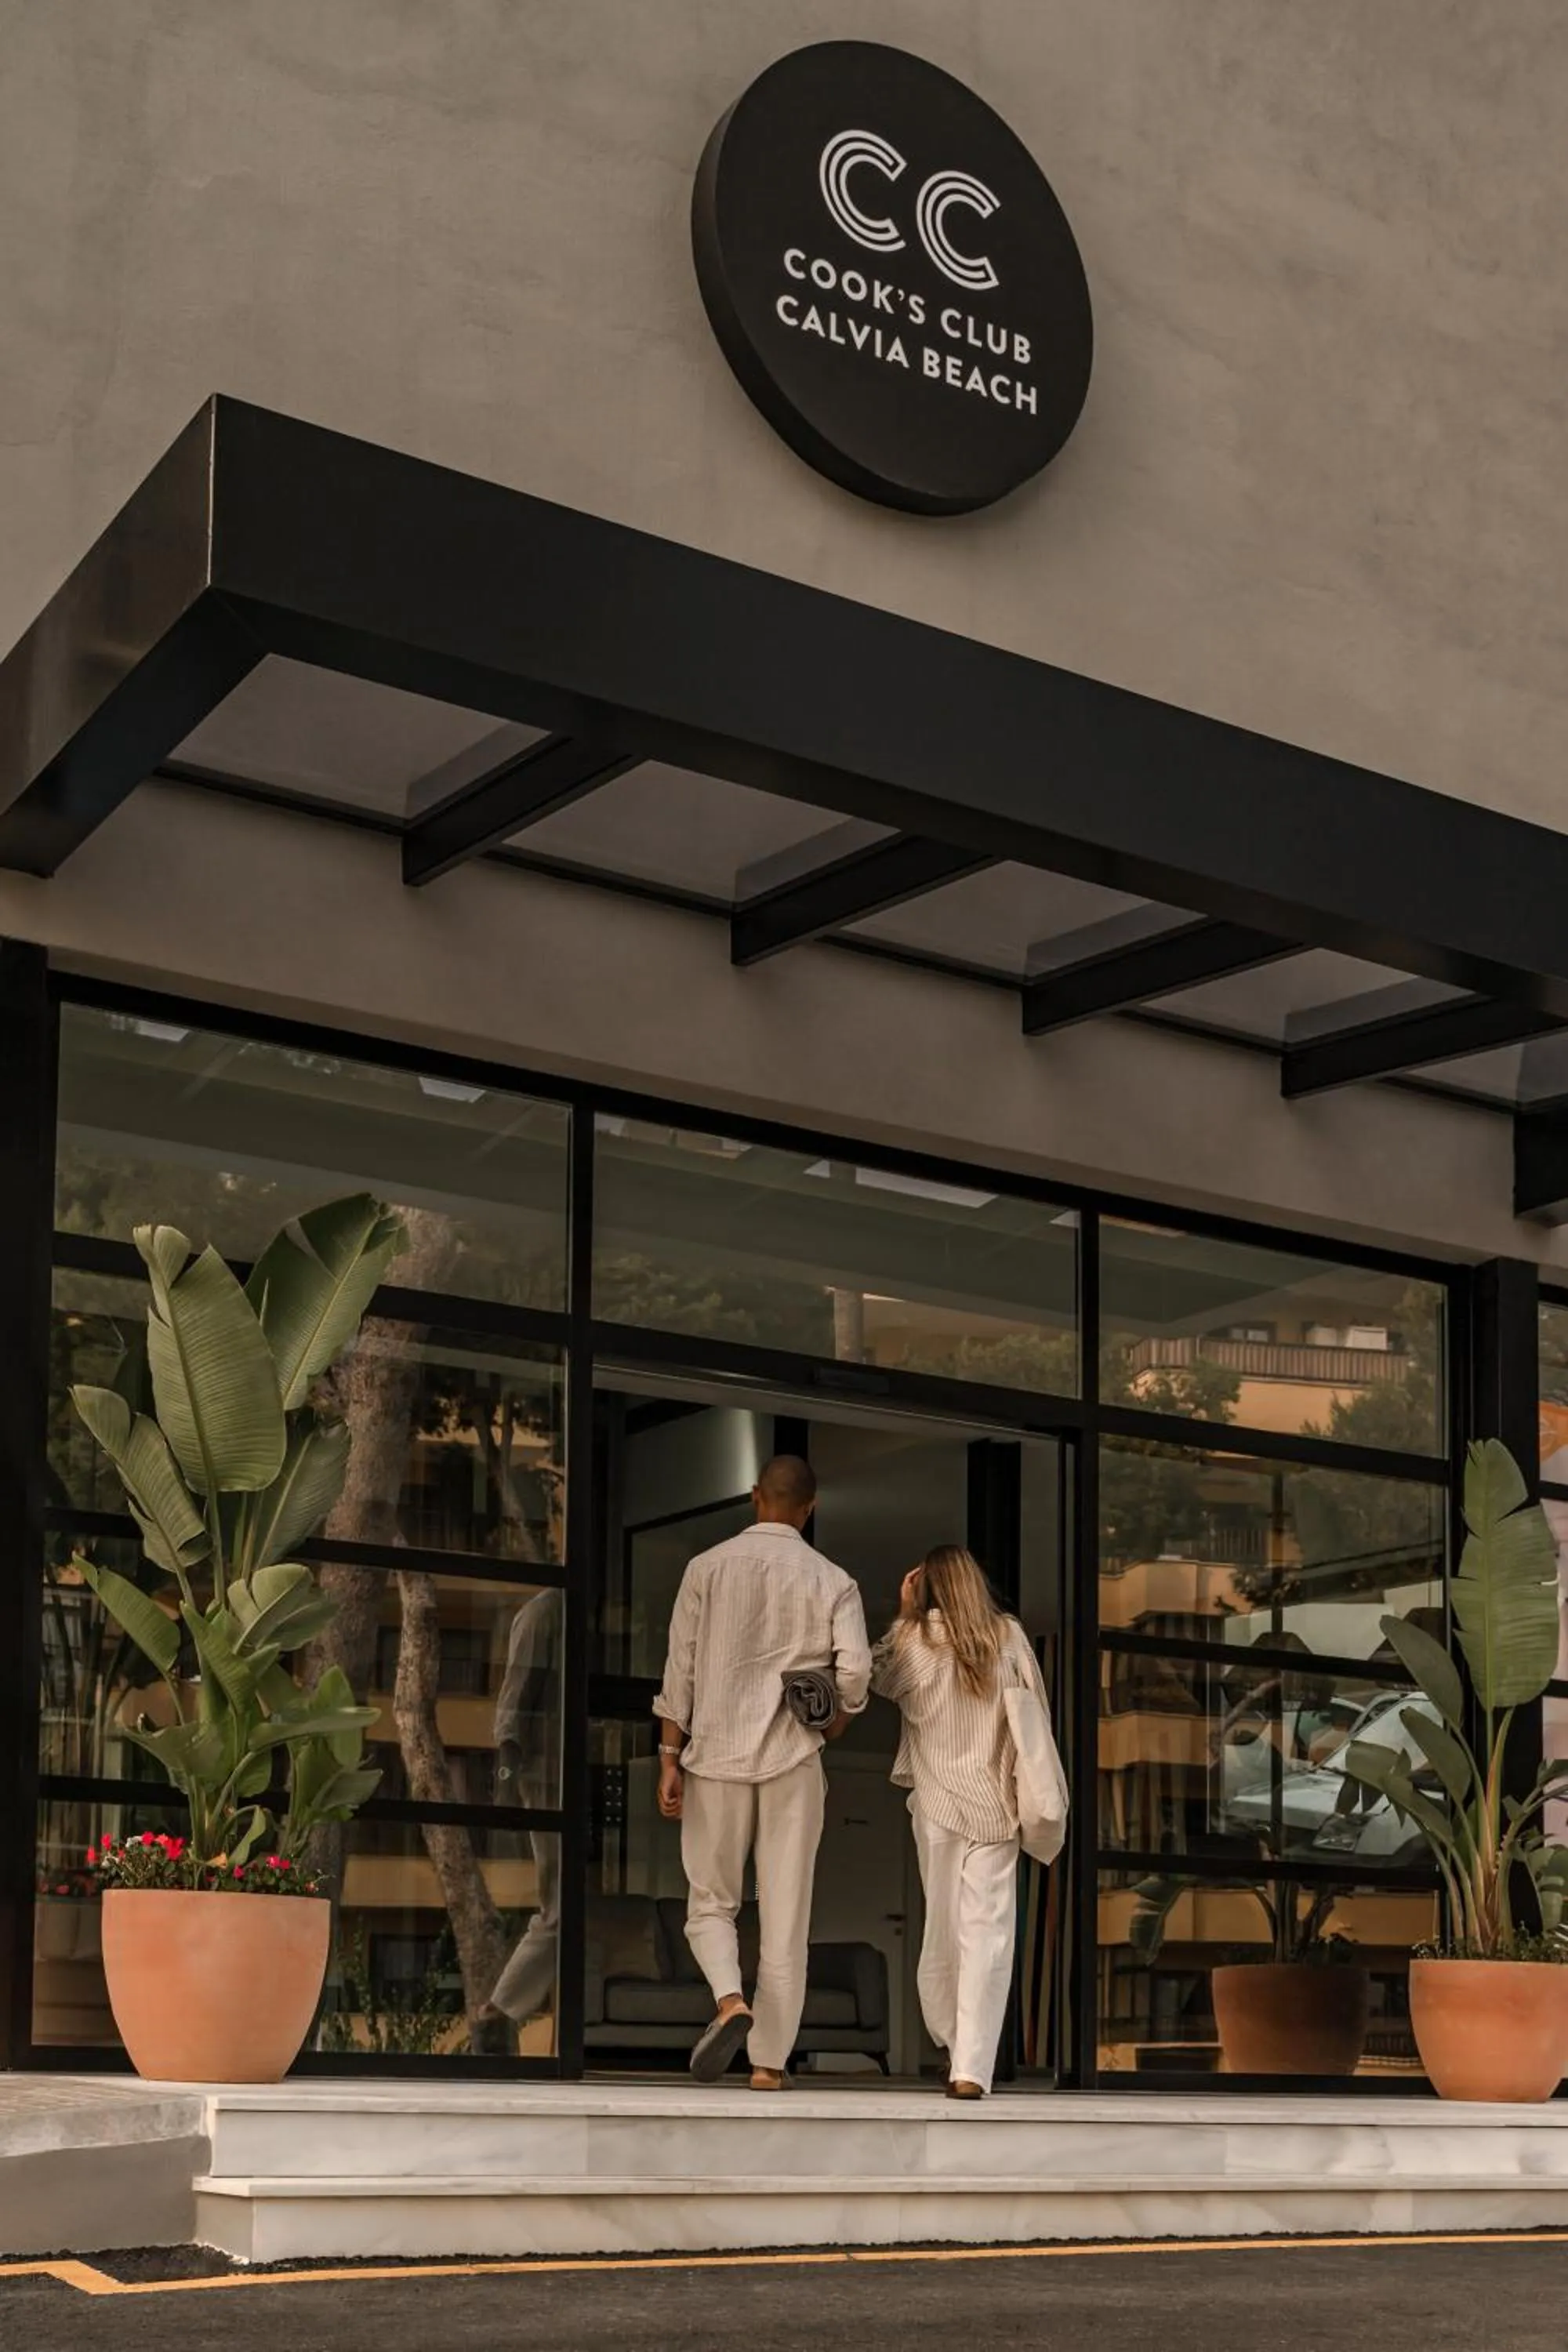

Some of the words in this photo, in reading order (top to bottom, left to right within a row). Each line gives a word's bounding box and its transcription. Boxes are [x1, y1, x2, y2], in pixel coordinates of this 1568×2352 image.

[776, 295, 909, 368] CALVIA
[923, 347, 1037, 415] BEACH
[783, 249, 925, 325] COOK'S
[940, 308, 1031, 364] CLUB
